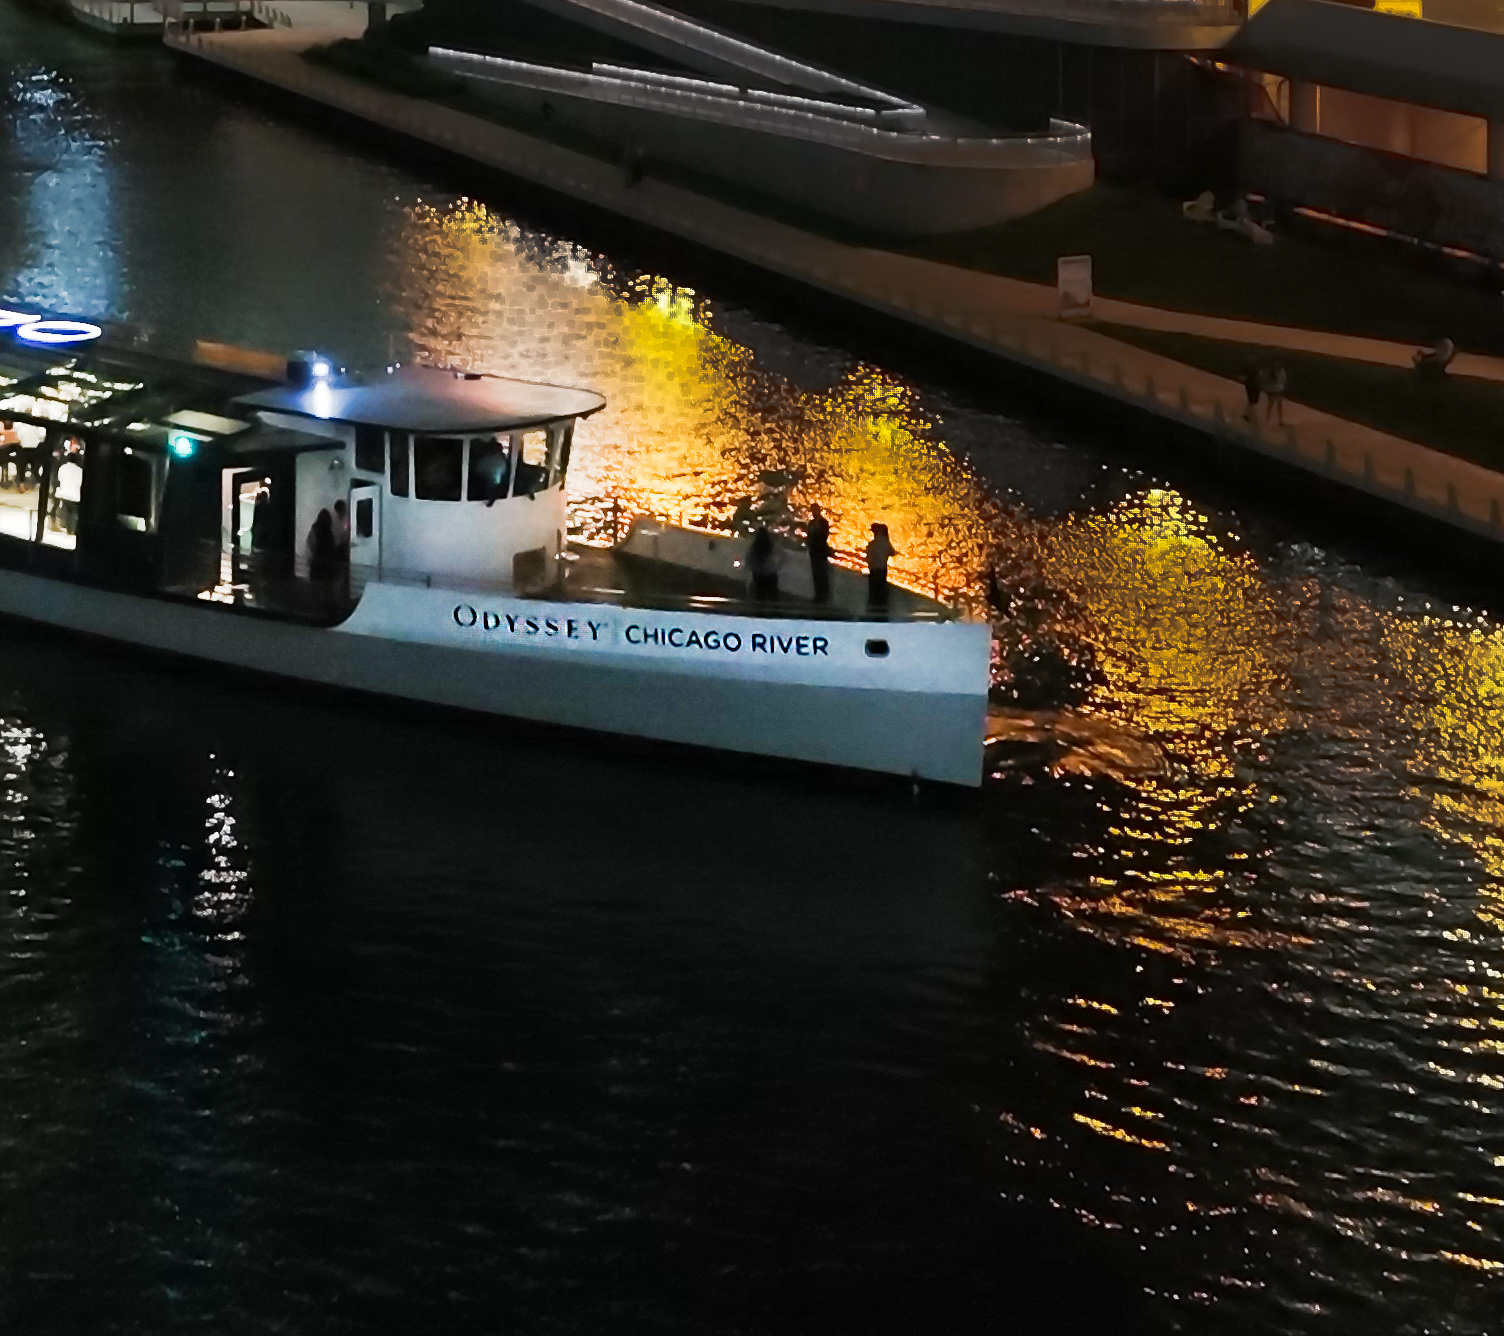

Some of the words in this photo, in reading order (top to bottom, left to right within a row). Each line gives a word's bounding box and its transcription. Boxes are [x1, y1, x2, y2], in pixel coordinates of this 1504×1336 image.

[452, 603, 603, 641] ODYSSEY
[625, 624, 743, 653] CHICAGO
[752, 634, 830, 657] RIVER
